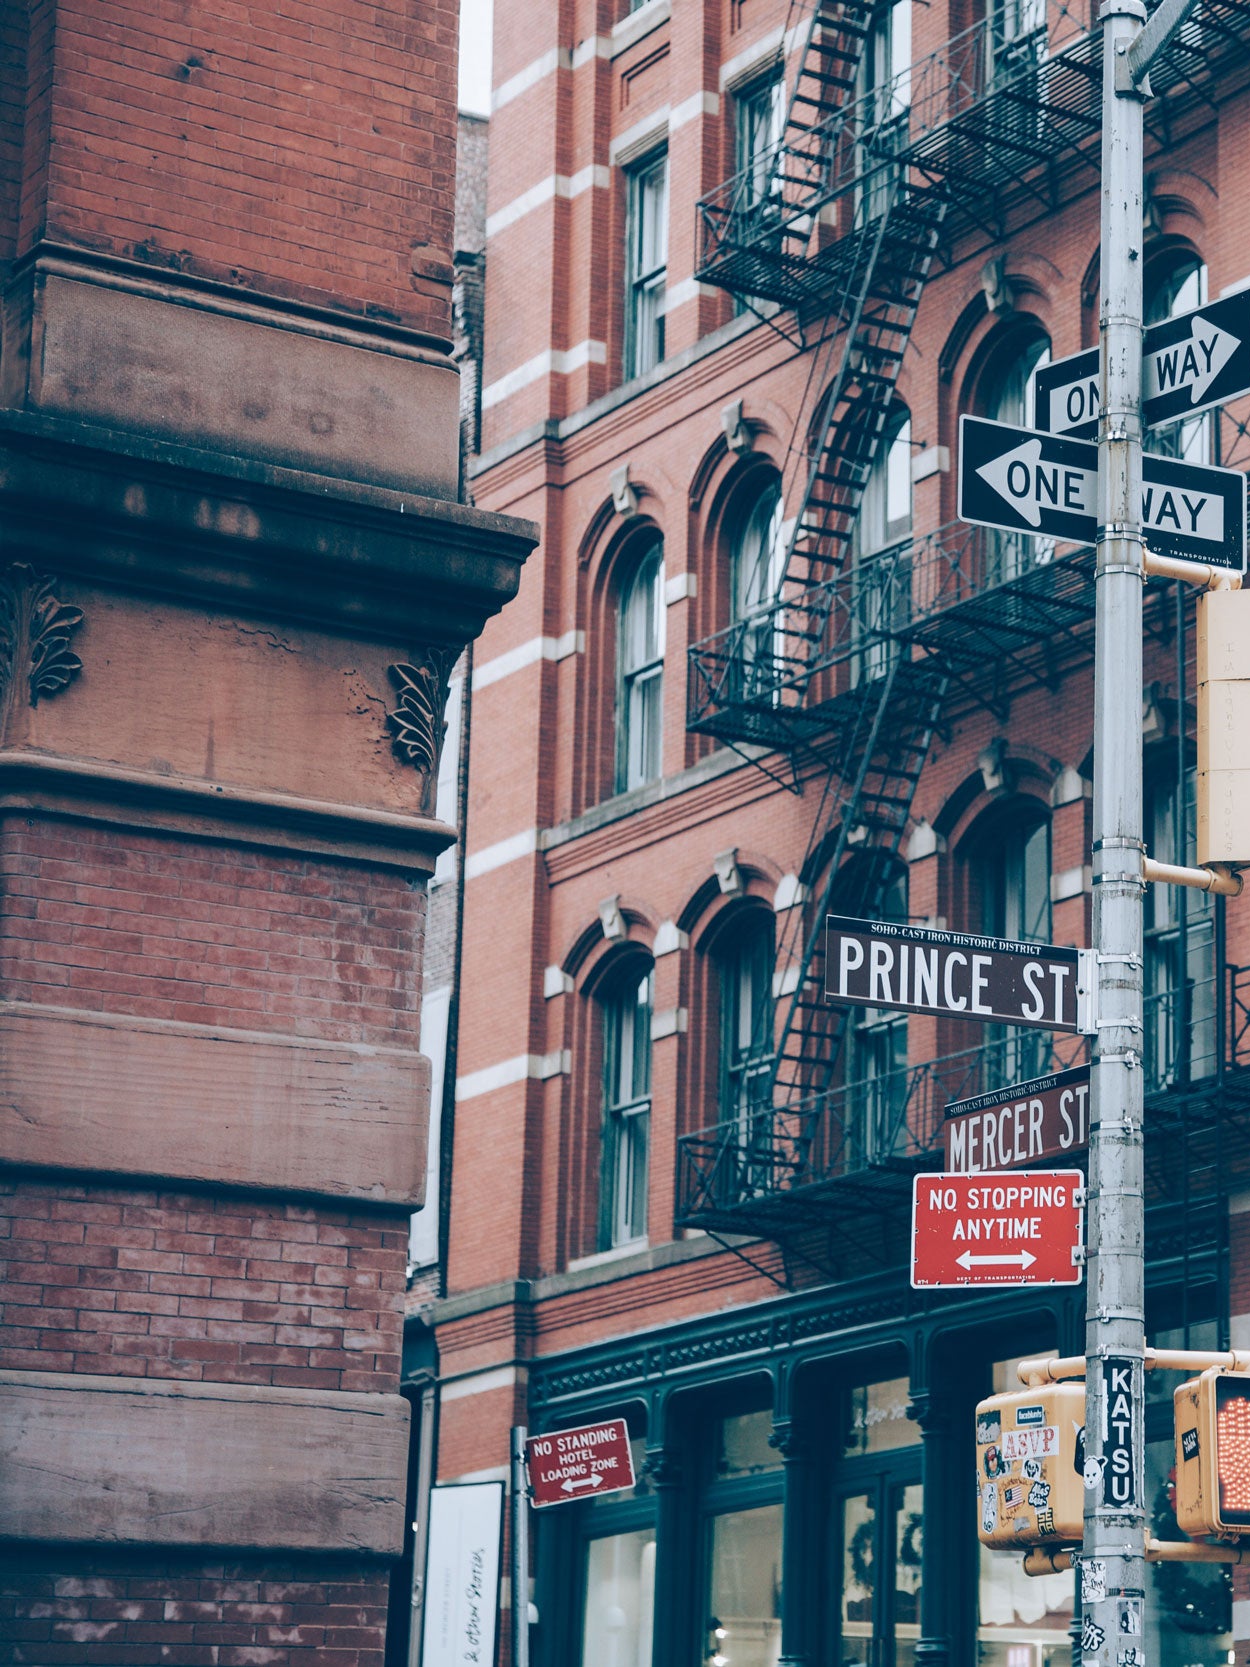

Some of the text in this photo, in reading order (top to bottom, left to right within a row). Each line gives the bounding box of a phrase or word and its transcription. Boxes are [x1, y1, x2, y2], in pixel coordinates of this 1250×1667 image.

[1066, 333, 1220, 423] ON WAY
[1006, 460, 1085, 511] ONE
[1170, 550, 1232, 565] TRANSPORTATION
[928, 931, 950, 943] IRON
[953, 935, 997, 949] HISTORIC
[999, 941, 1042, 955] DISTRICT
[839, 936, 1069, 1024] PRINCE ST
[983, 1096, 999, 1106] IRON
[949, 1085, 1089, 1173] MERCER ST
[929, 1186, 1066, 1210] NO STOPPING
[952, 1217, 1042, 1241] ANYTIME
[533, 1428, 617, 1457] NO STANDING
[1004, 1428, 1055, 1459] ASVP
[1111, 1367, 1131, 1501] KATSU
[541, 1457, 619, 1483] LOADING ZONE
[559, 1449, 597, 1465] HOTEL
